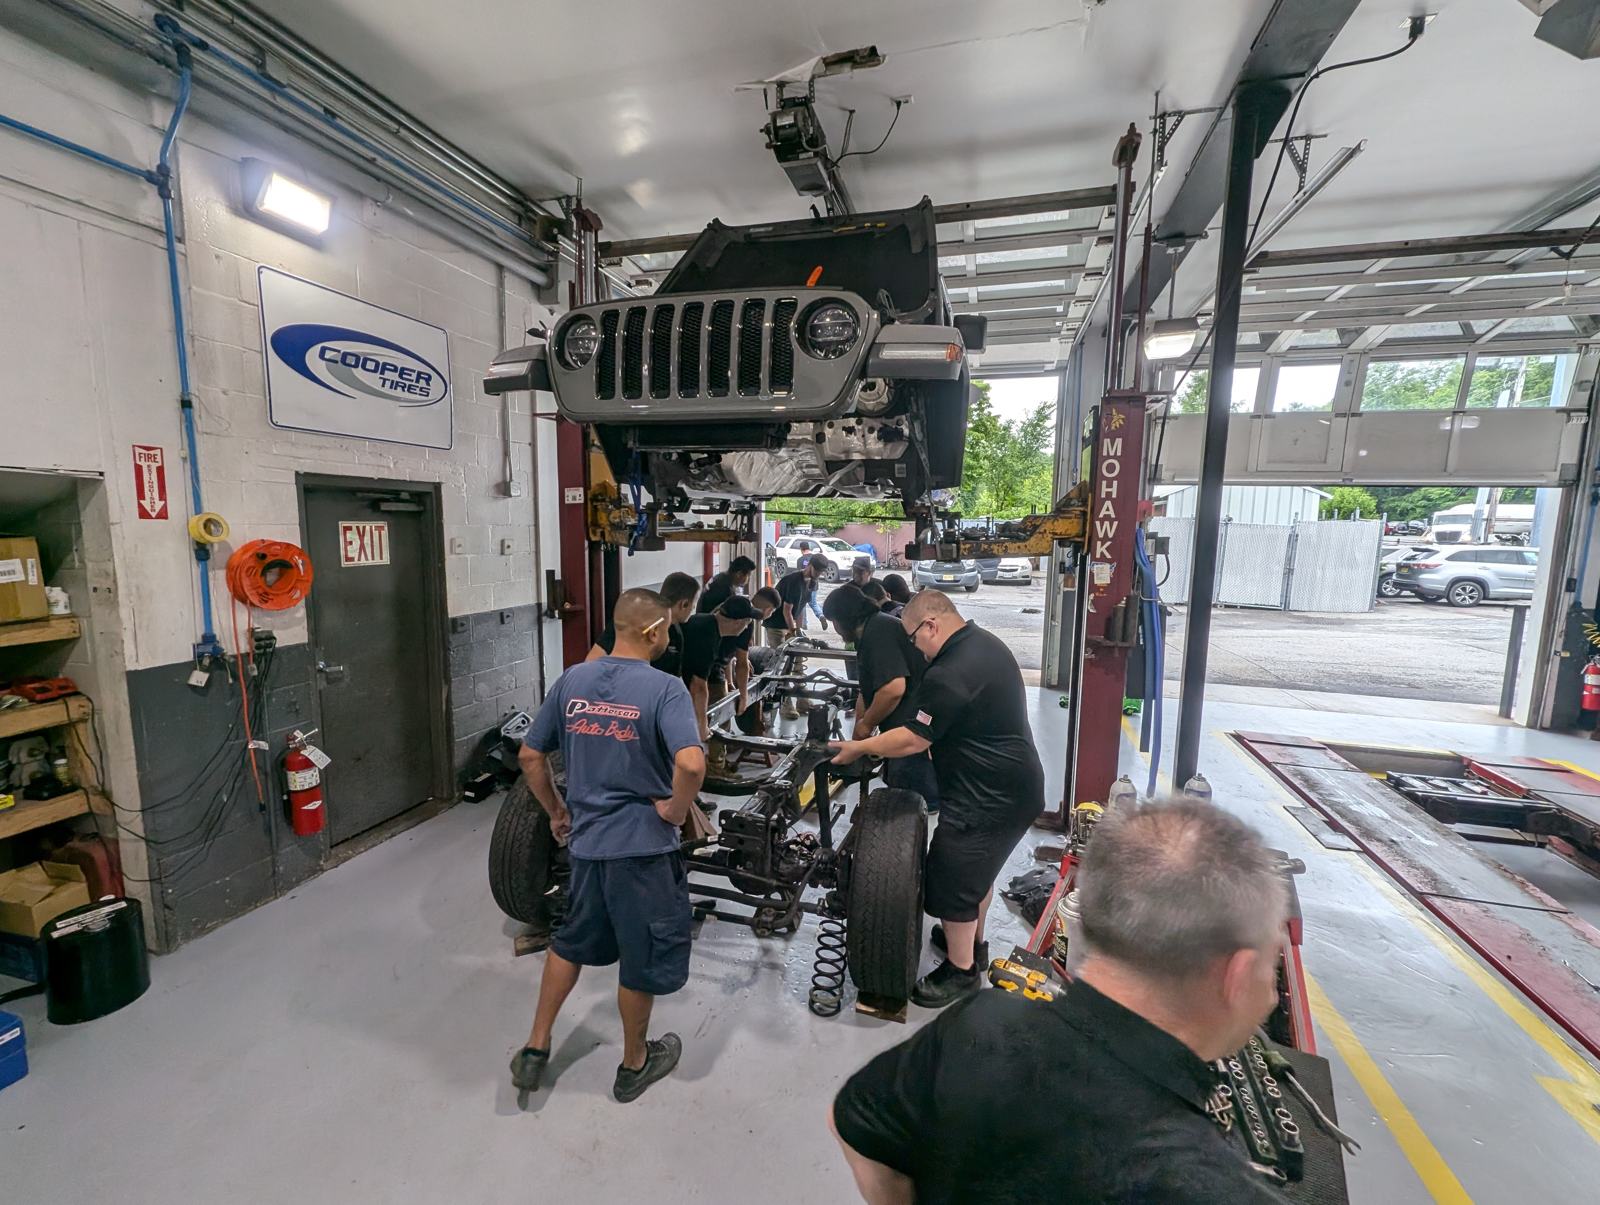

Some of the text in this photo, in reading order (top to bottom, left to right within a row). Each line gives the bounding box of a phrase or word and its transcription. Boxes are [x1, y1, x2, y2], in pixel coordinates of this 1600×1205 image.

[318, 345, 433, 387] COOPER
[379, 376, 431, 398] TIRES
[138, 452, 159, 463] FIRE
[1095, 438, 1122, 559] MOHAWK
[343, 525, 385, 562] EXIT
[566, 718, 640, 741] Auto Body
